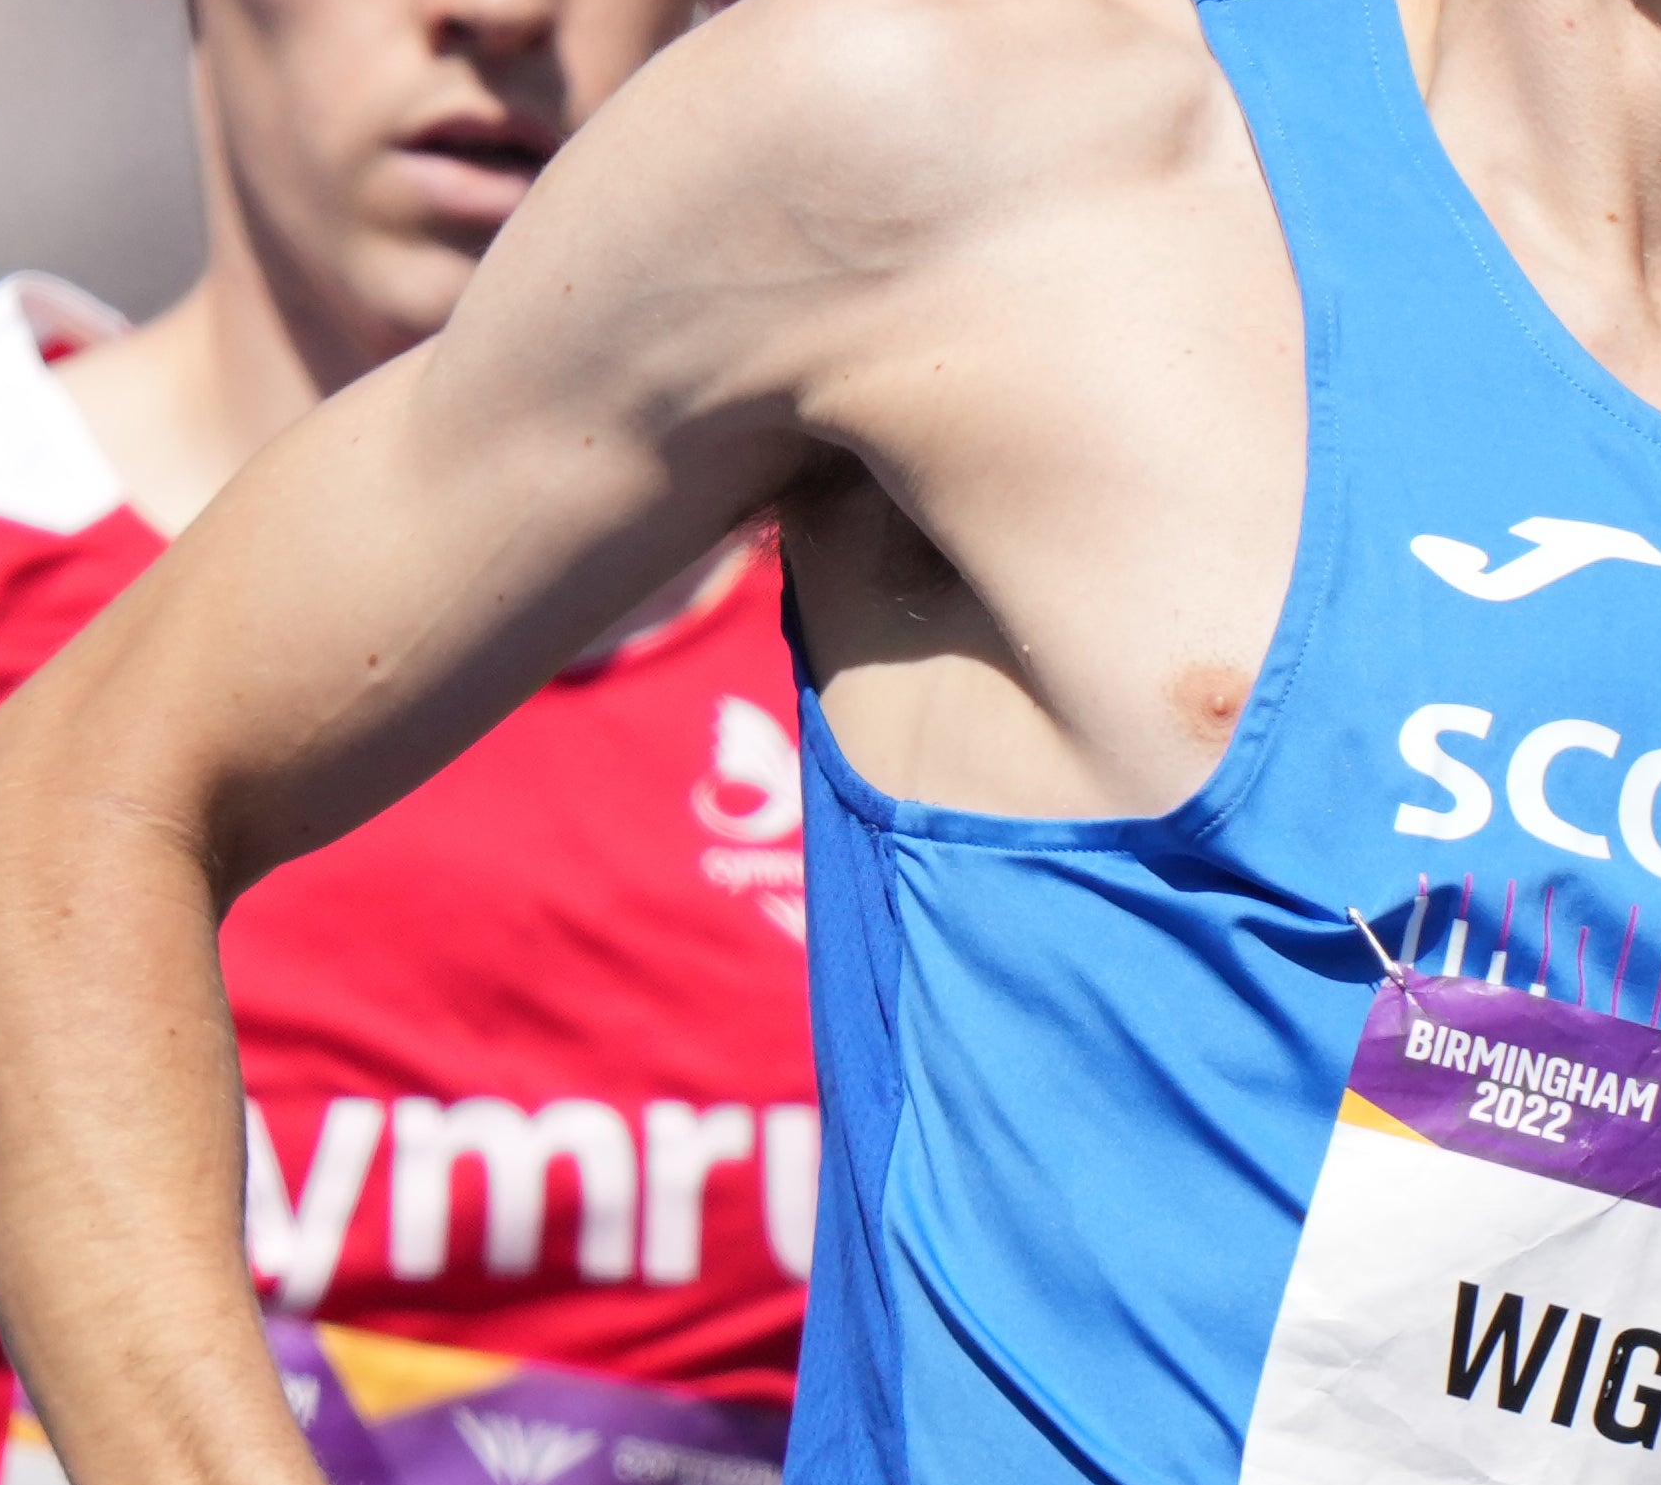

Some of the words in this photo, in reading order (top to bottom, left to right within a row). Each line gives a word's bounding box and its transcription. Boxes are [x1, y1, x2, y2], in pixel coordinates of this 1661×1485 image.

[1404, 1018, 1660, 1124] BIRMINGHAM
[1468, 1080, 1574, 1144] 2022
[242, 1092, 821, 1316] ymr
